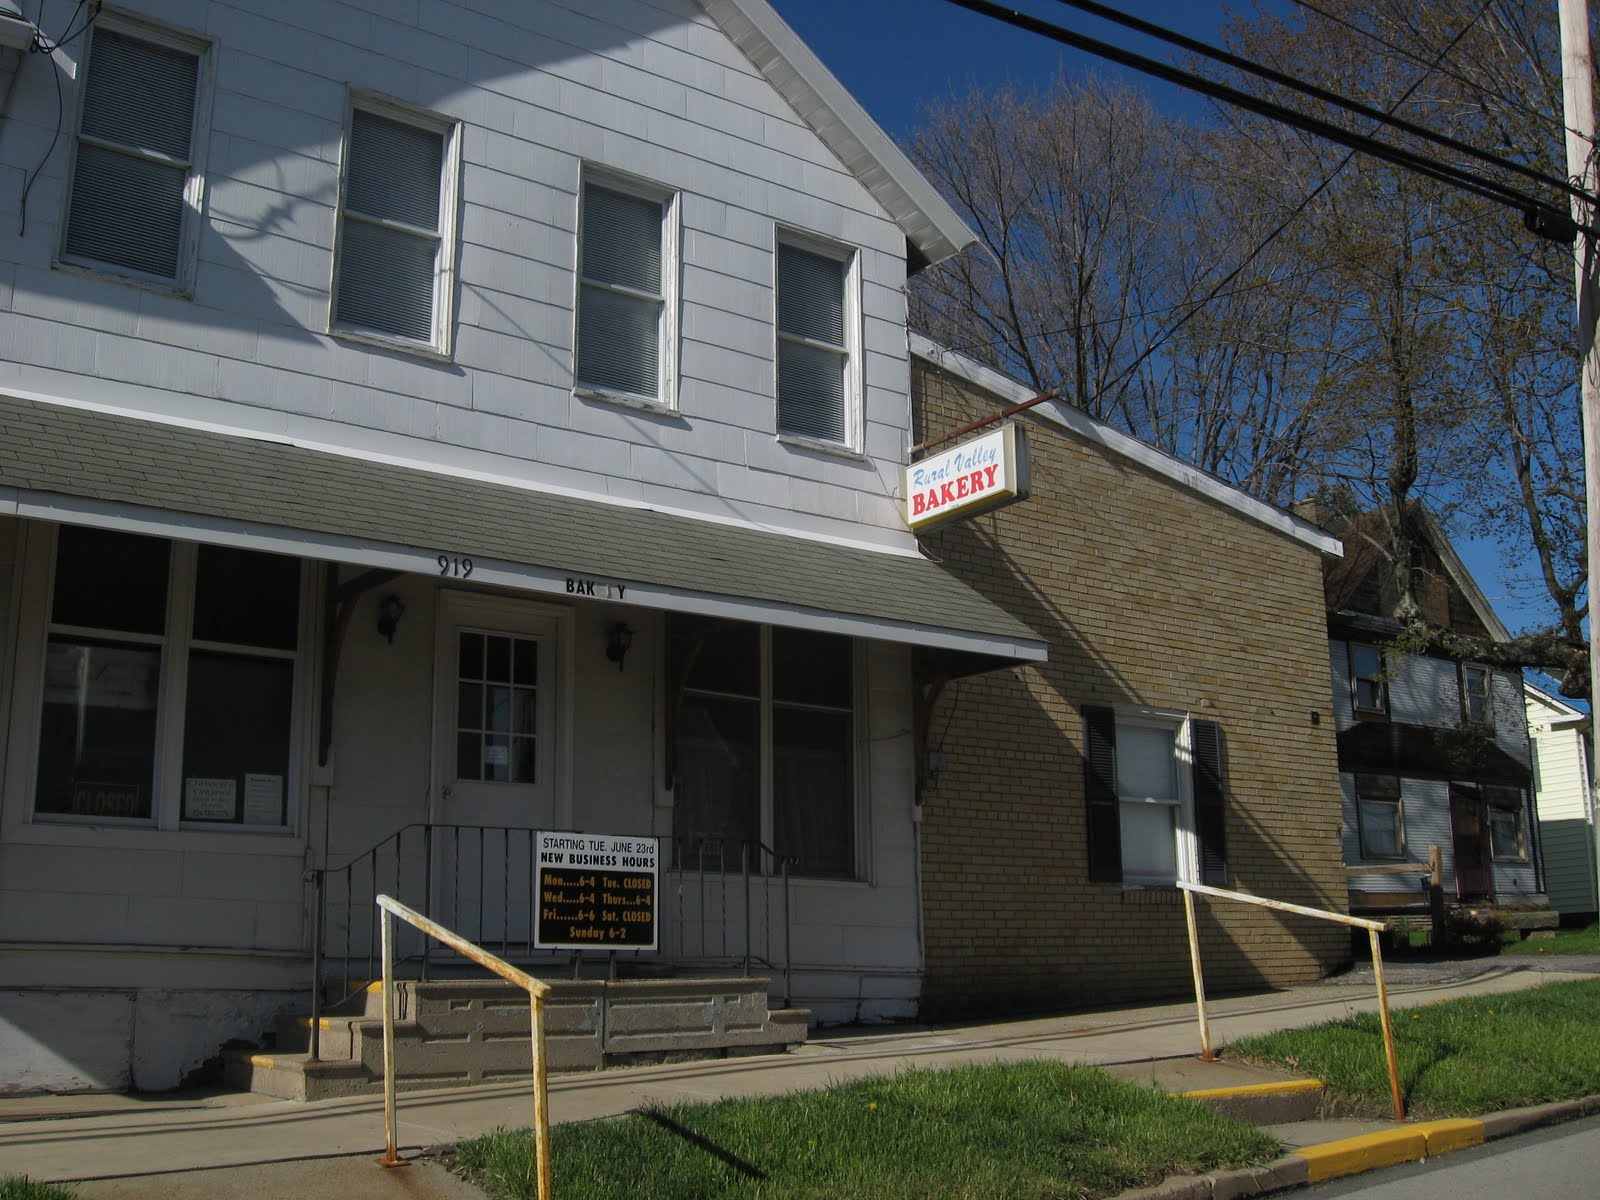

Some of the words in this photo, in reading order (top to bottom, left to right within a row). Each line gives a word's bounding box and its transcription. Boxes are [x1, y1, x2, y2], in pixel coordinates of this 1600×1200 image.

[913, 459, 950, 487] Rural
[954, 445, 997, 472] Valley
[912, 463, 999, 516] BAKERY
[438, 555, 474, 578] 919
[543, 838, 585, 850] STARTING
[588, 840, 608, 852] TUE.
[611, 842, 633, 853] JUNE
[636, 843, 655, 854] 23rd
[540, 852, 564, 864] NEW
[569, 853, 617, 867] BUSINESS
[622, 856, 655, 868] HOURS
[602, 877, 620, 888] Tue.
[623, 878, 652, 890] CLOSED
[601, 910, 620, 922] Sat.
[622, 911, 652, 923] CLOSED
[569, 926, 605, 940] Sunday
[608, 928, 627, 939] 6-2
